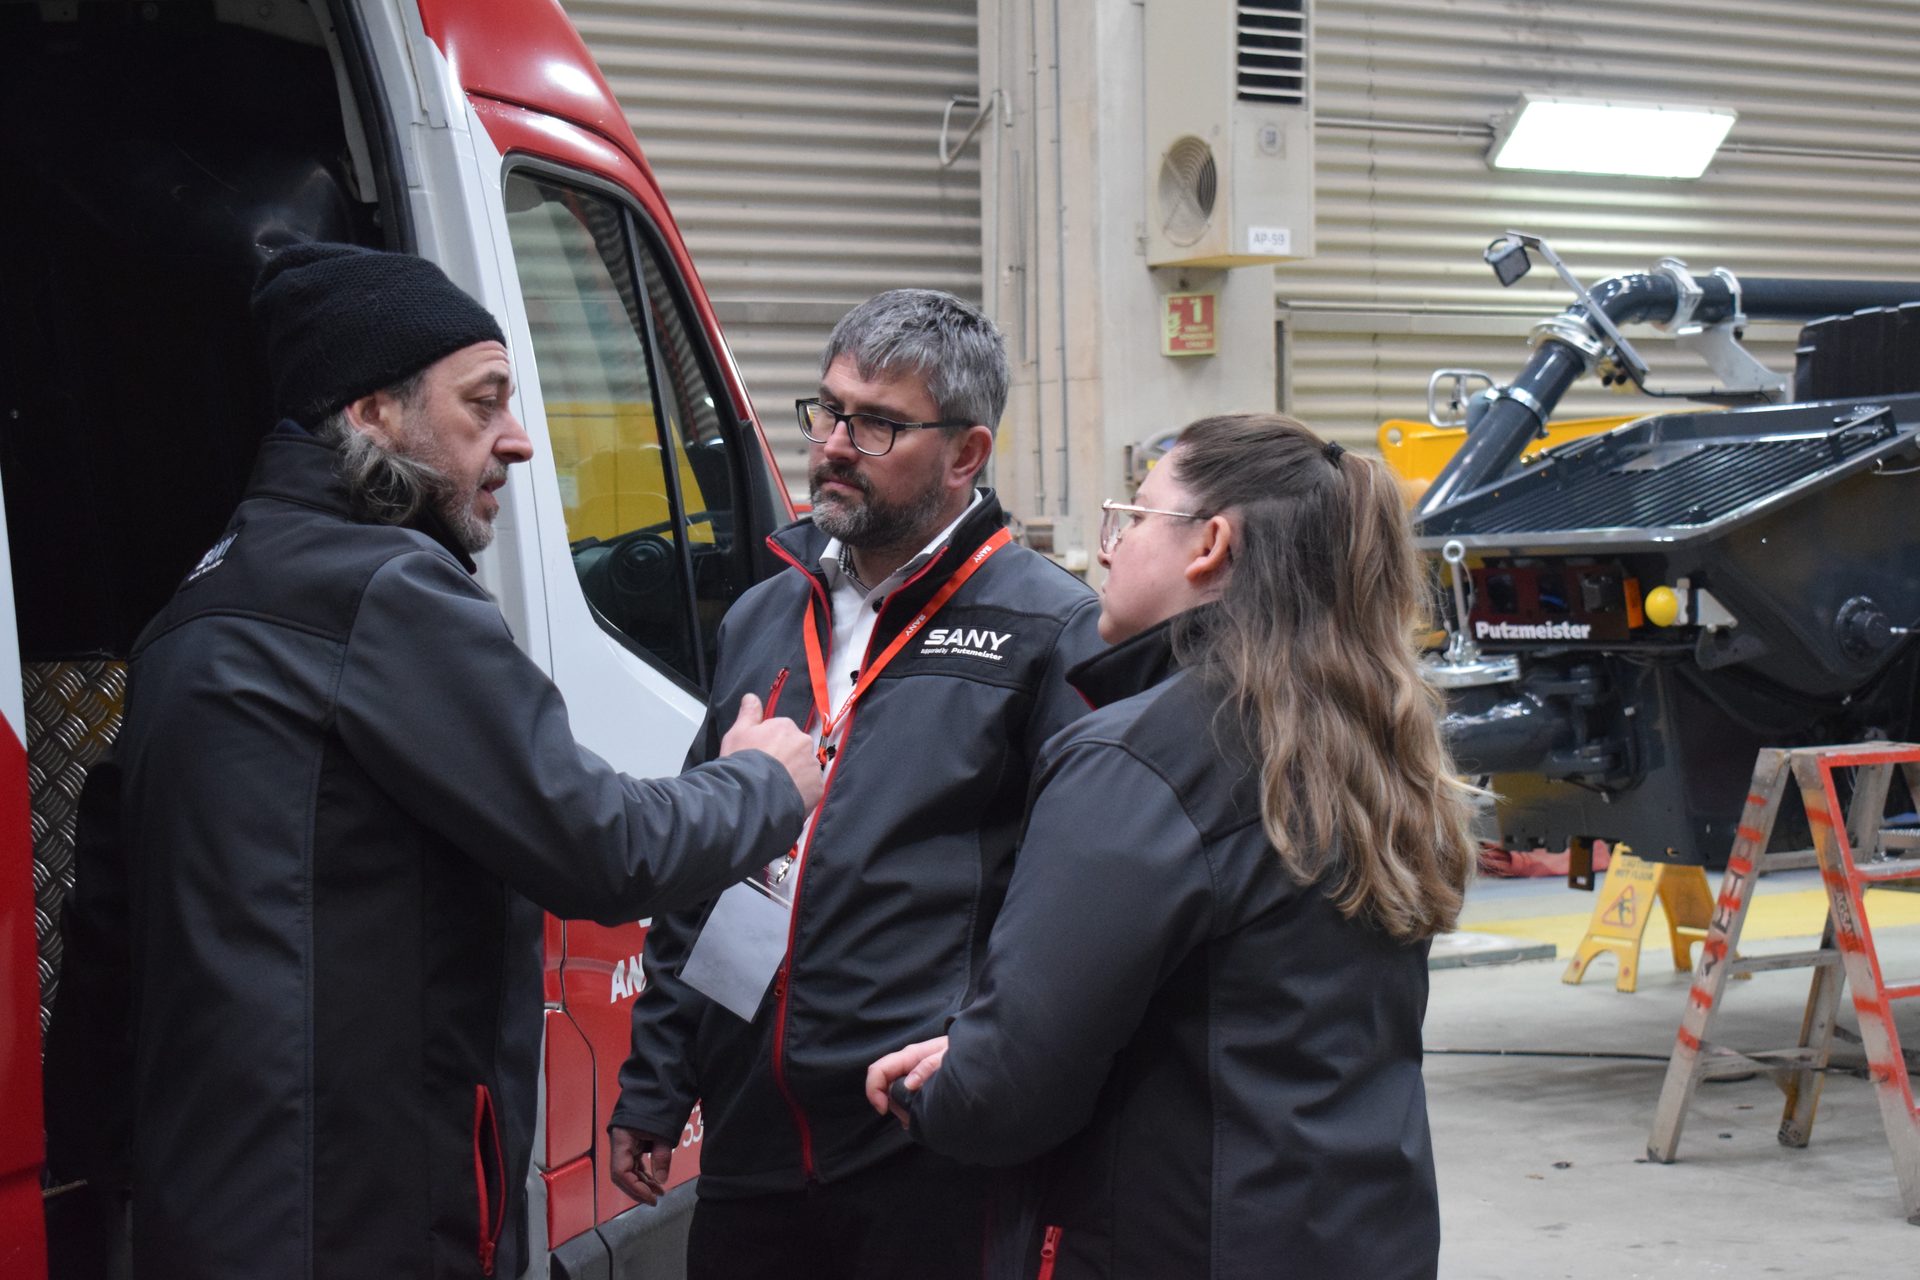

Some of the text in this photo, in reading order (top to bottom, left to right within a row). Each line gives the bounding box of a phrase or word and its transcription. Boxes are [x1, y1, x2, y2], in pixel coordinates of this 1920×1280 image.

[973, 545, 992, 563] SANY
[906, 614, 926, 636] SANY
[1475, 621, 1591, 639] Putzmeister
[924, 628, 1012, 651] SANY
[951, 647, 1003, 661] Putzmeister
[610, 952, 647, 1004] AN
